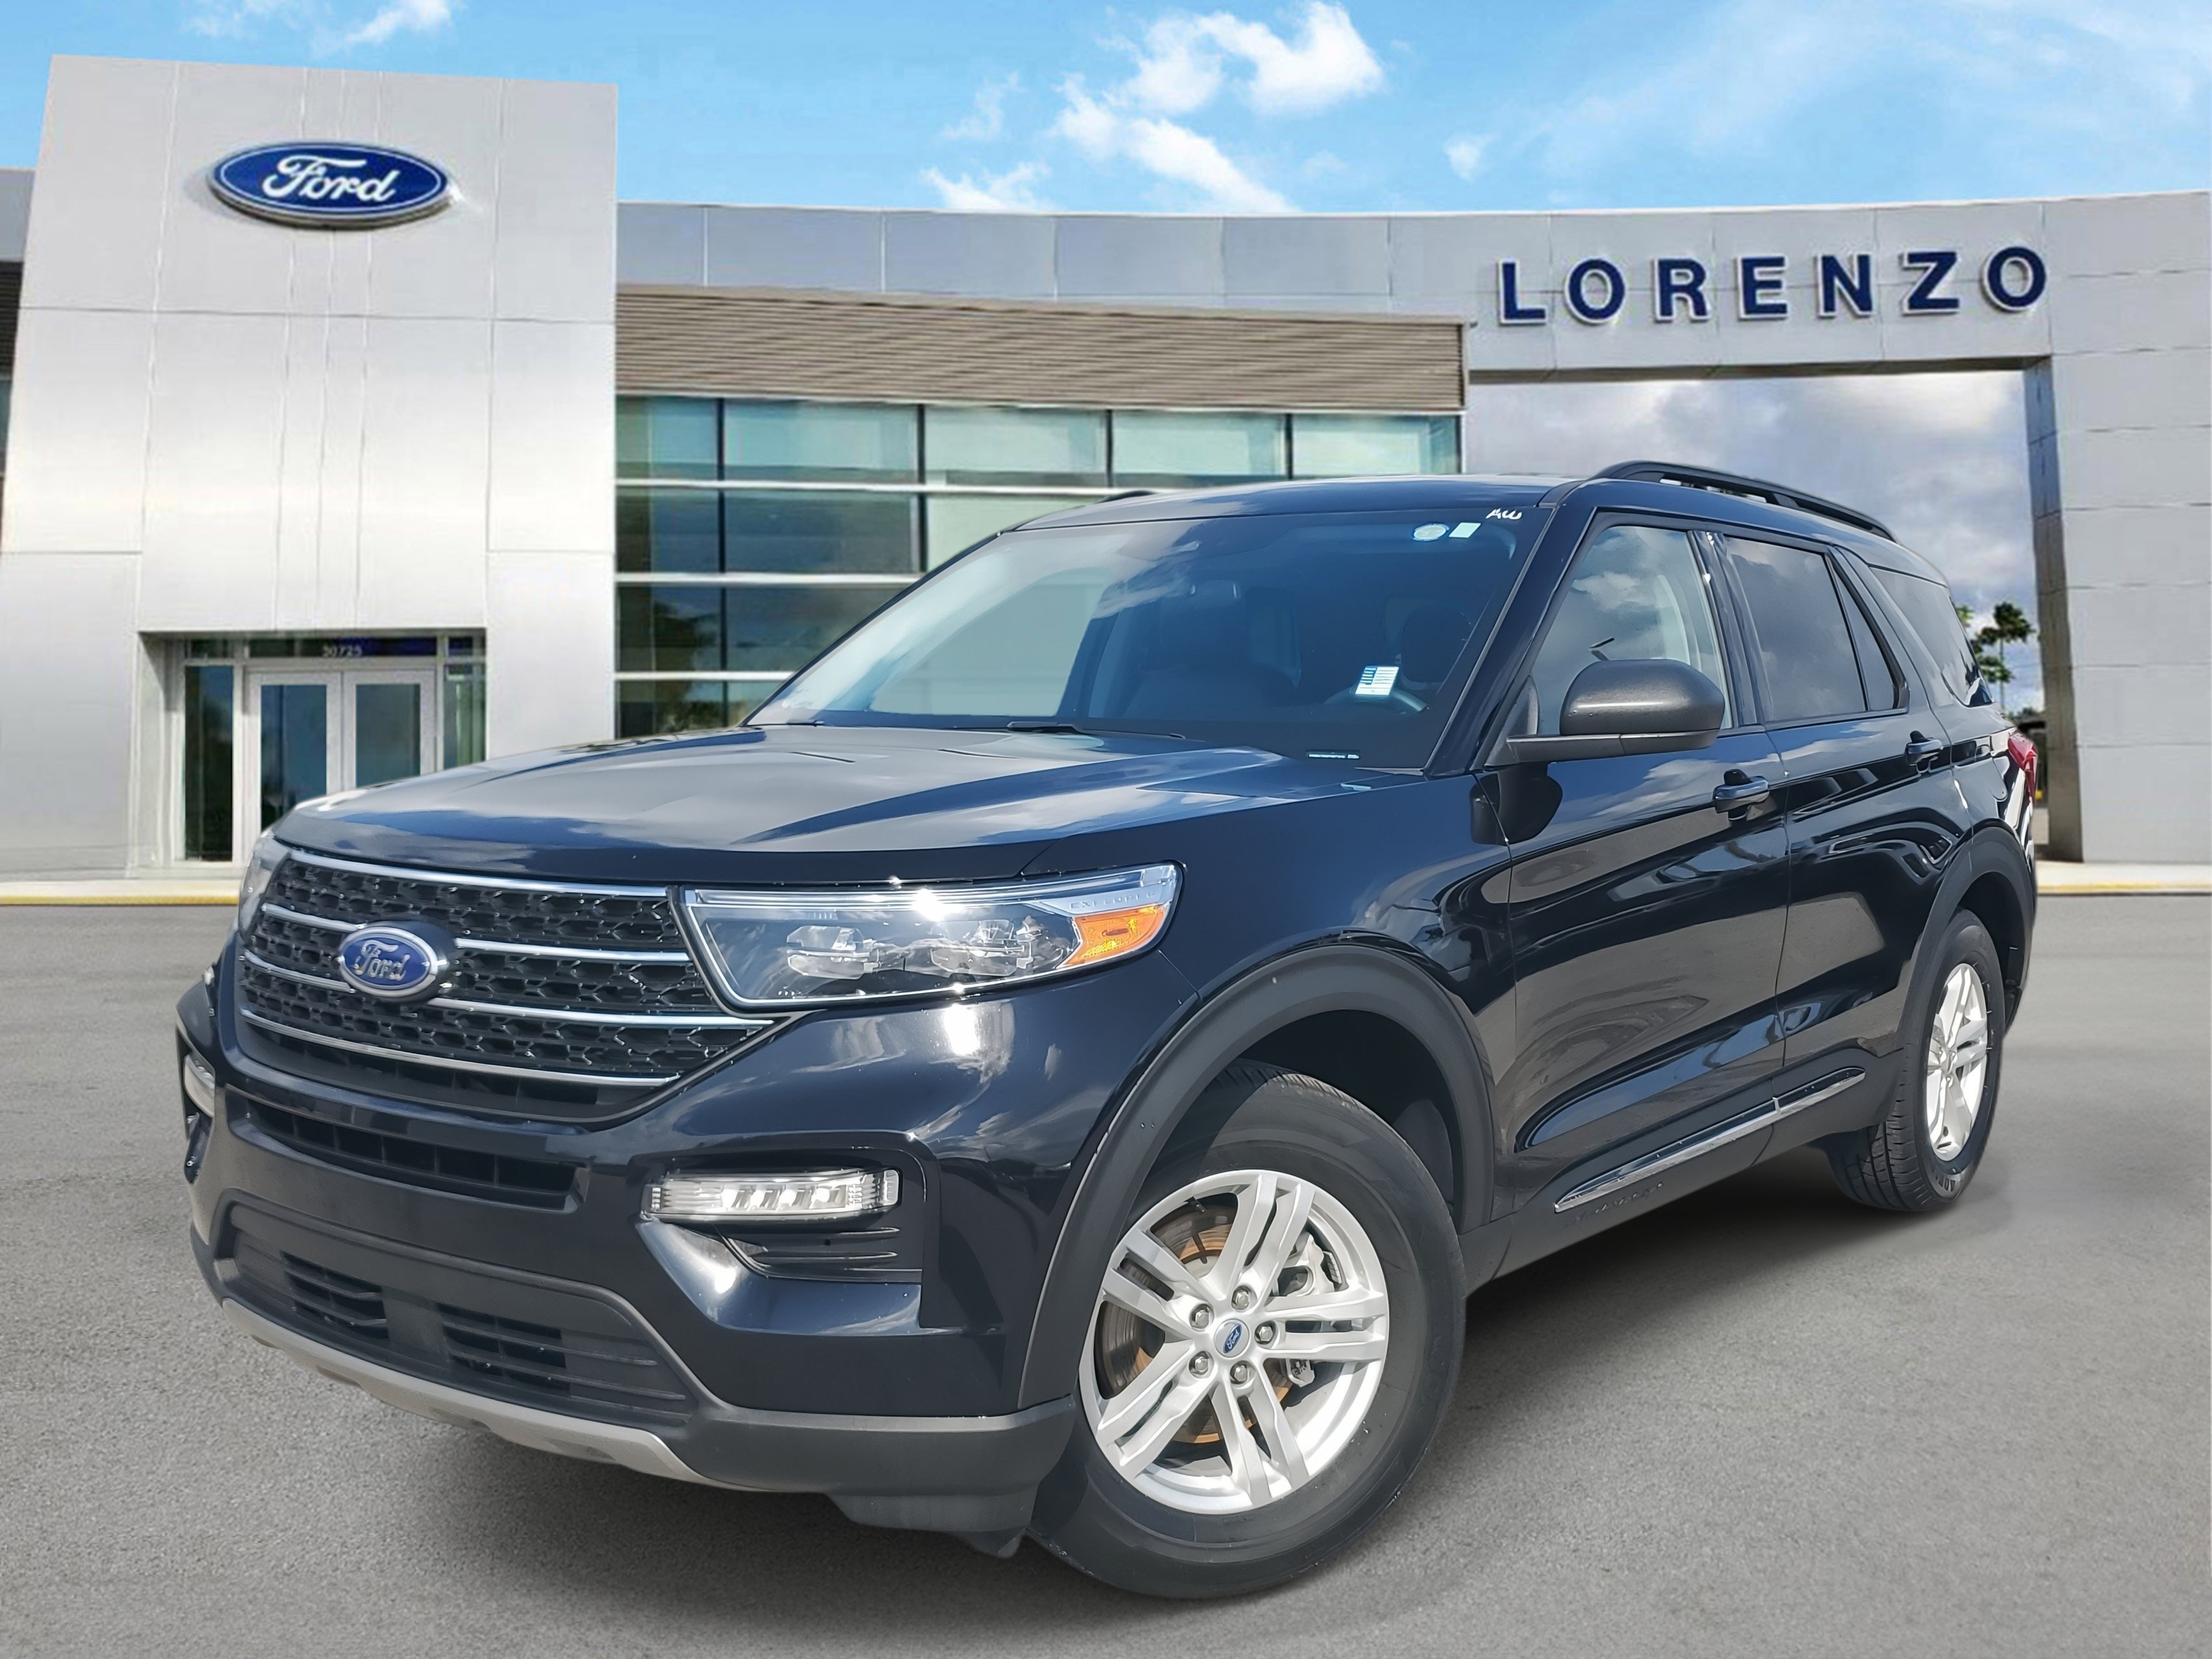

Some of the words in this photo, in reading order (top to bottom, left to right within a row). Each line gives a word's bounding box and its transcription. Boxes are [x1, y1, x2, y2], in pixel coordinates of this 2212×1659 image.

[262, 155, 401, 202] Ford
[1497, 246, 2048, 324] LORENZO
[353, 940, 411, 981] Ford
[1227, 1328, 1239, 1350] Ford
